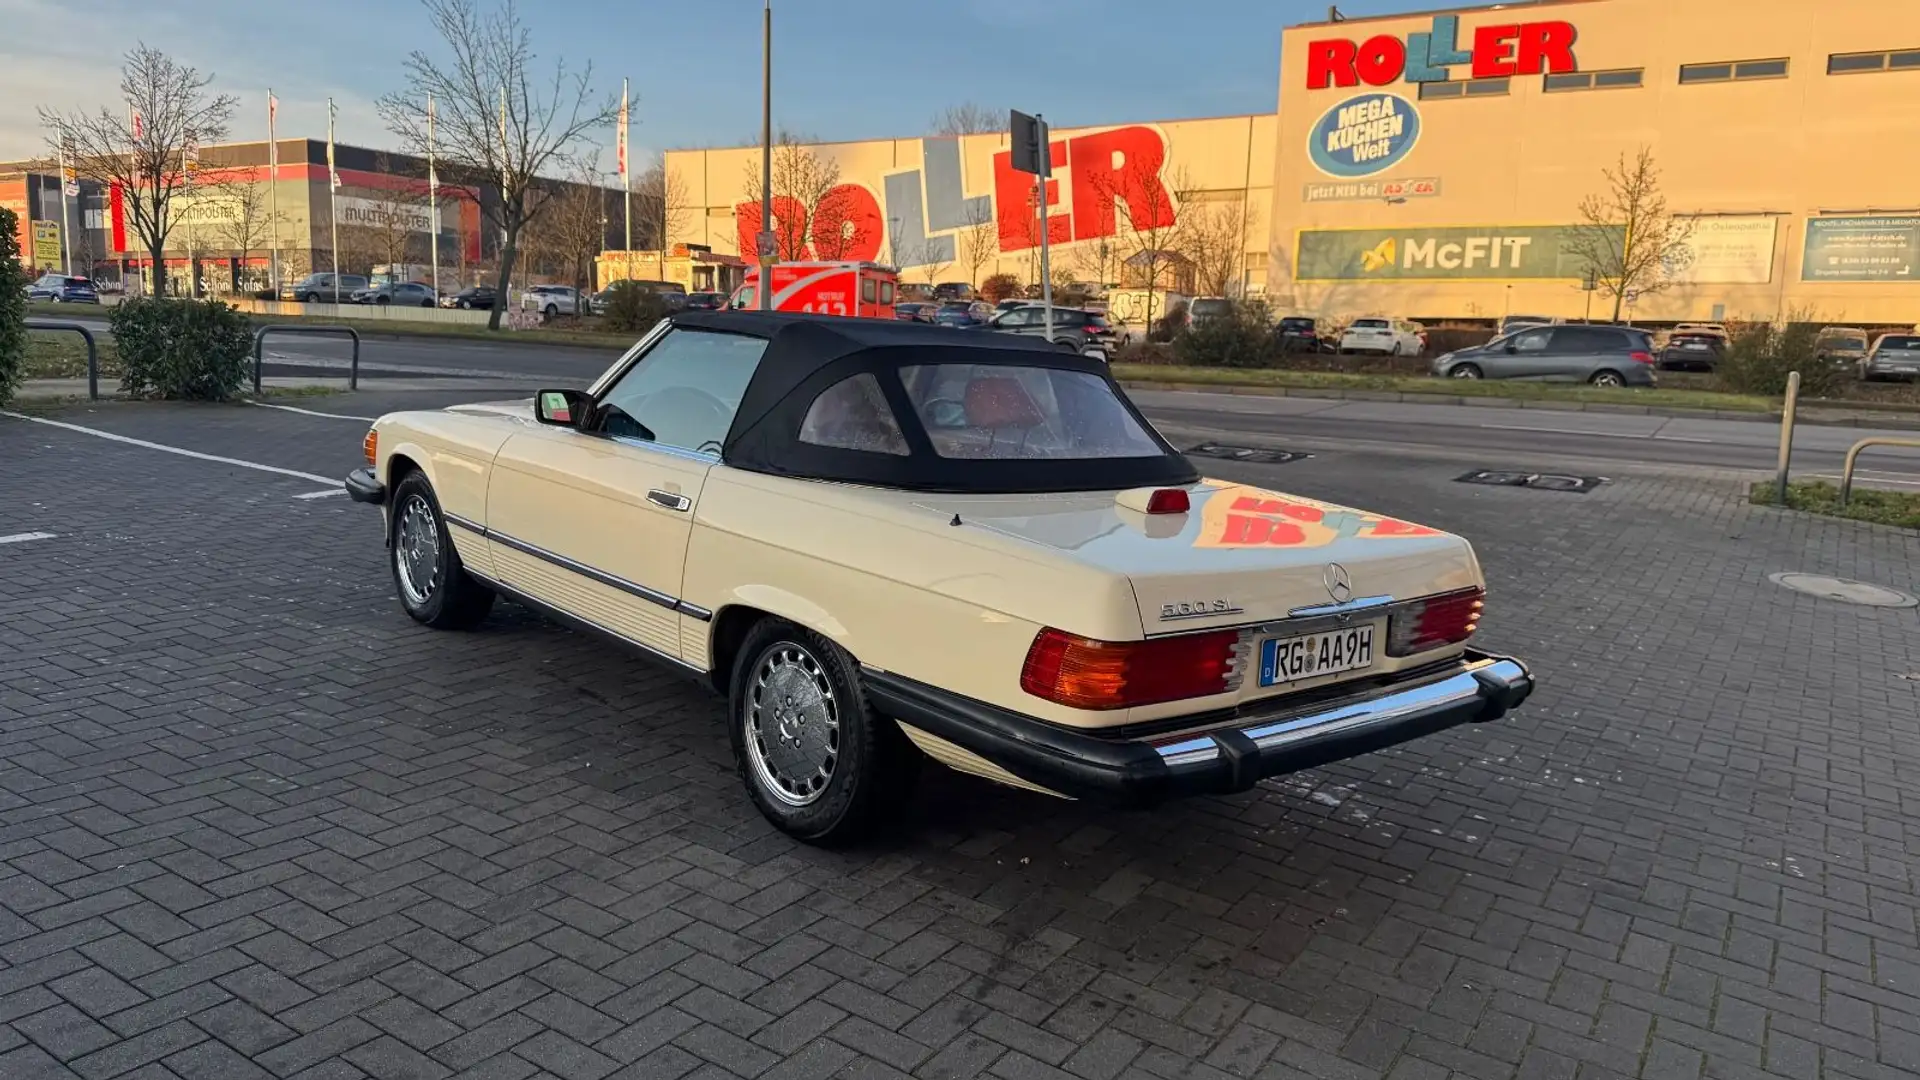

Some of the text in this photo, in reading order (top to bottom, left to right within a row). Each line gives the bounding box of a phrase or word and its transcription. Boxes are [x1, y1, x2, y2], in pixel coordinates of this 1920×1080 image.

[1307, 15, 1577, 89] ROLLER
[1338, 96, 1394, 129] MEGA
[1352, 138, 1391, 163] Welt
[736, 126, 1178, 266] ROLLER
[1335, 184, 1357, 198] NEU
[1360, 182, 1379, 196] bei
[1403, 237, 1531, 269] McFIT
[1161, 602, 1206, 616] 560
[1264, 666, 1271, 678] D
[1275, 641, 1304, 678] RG
